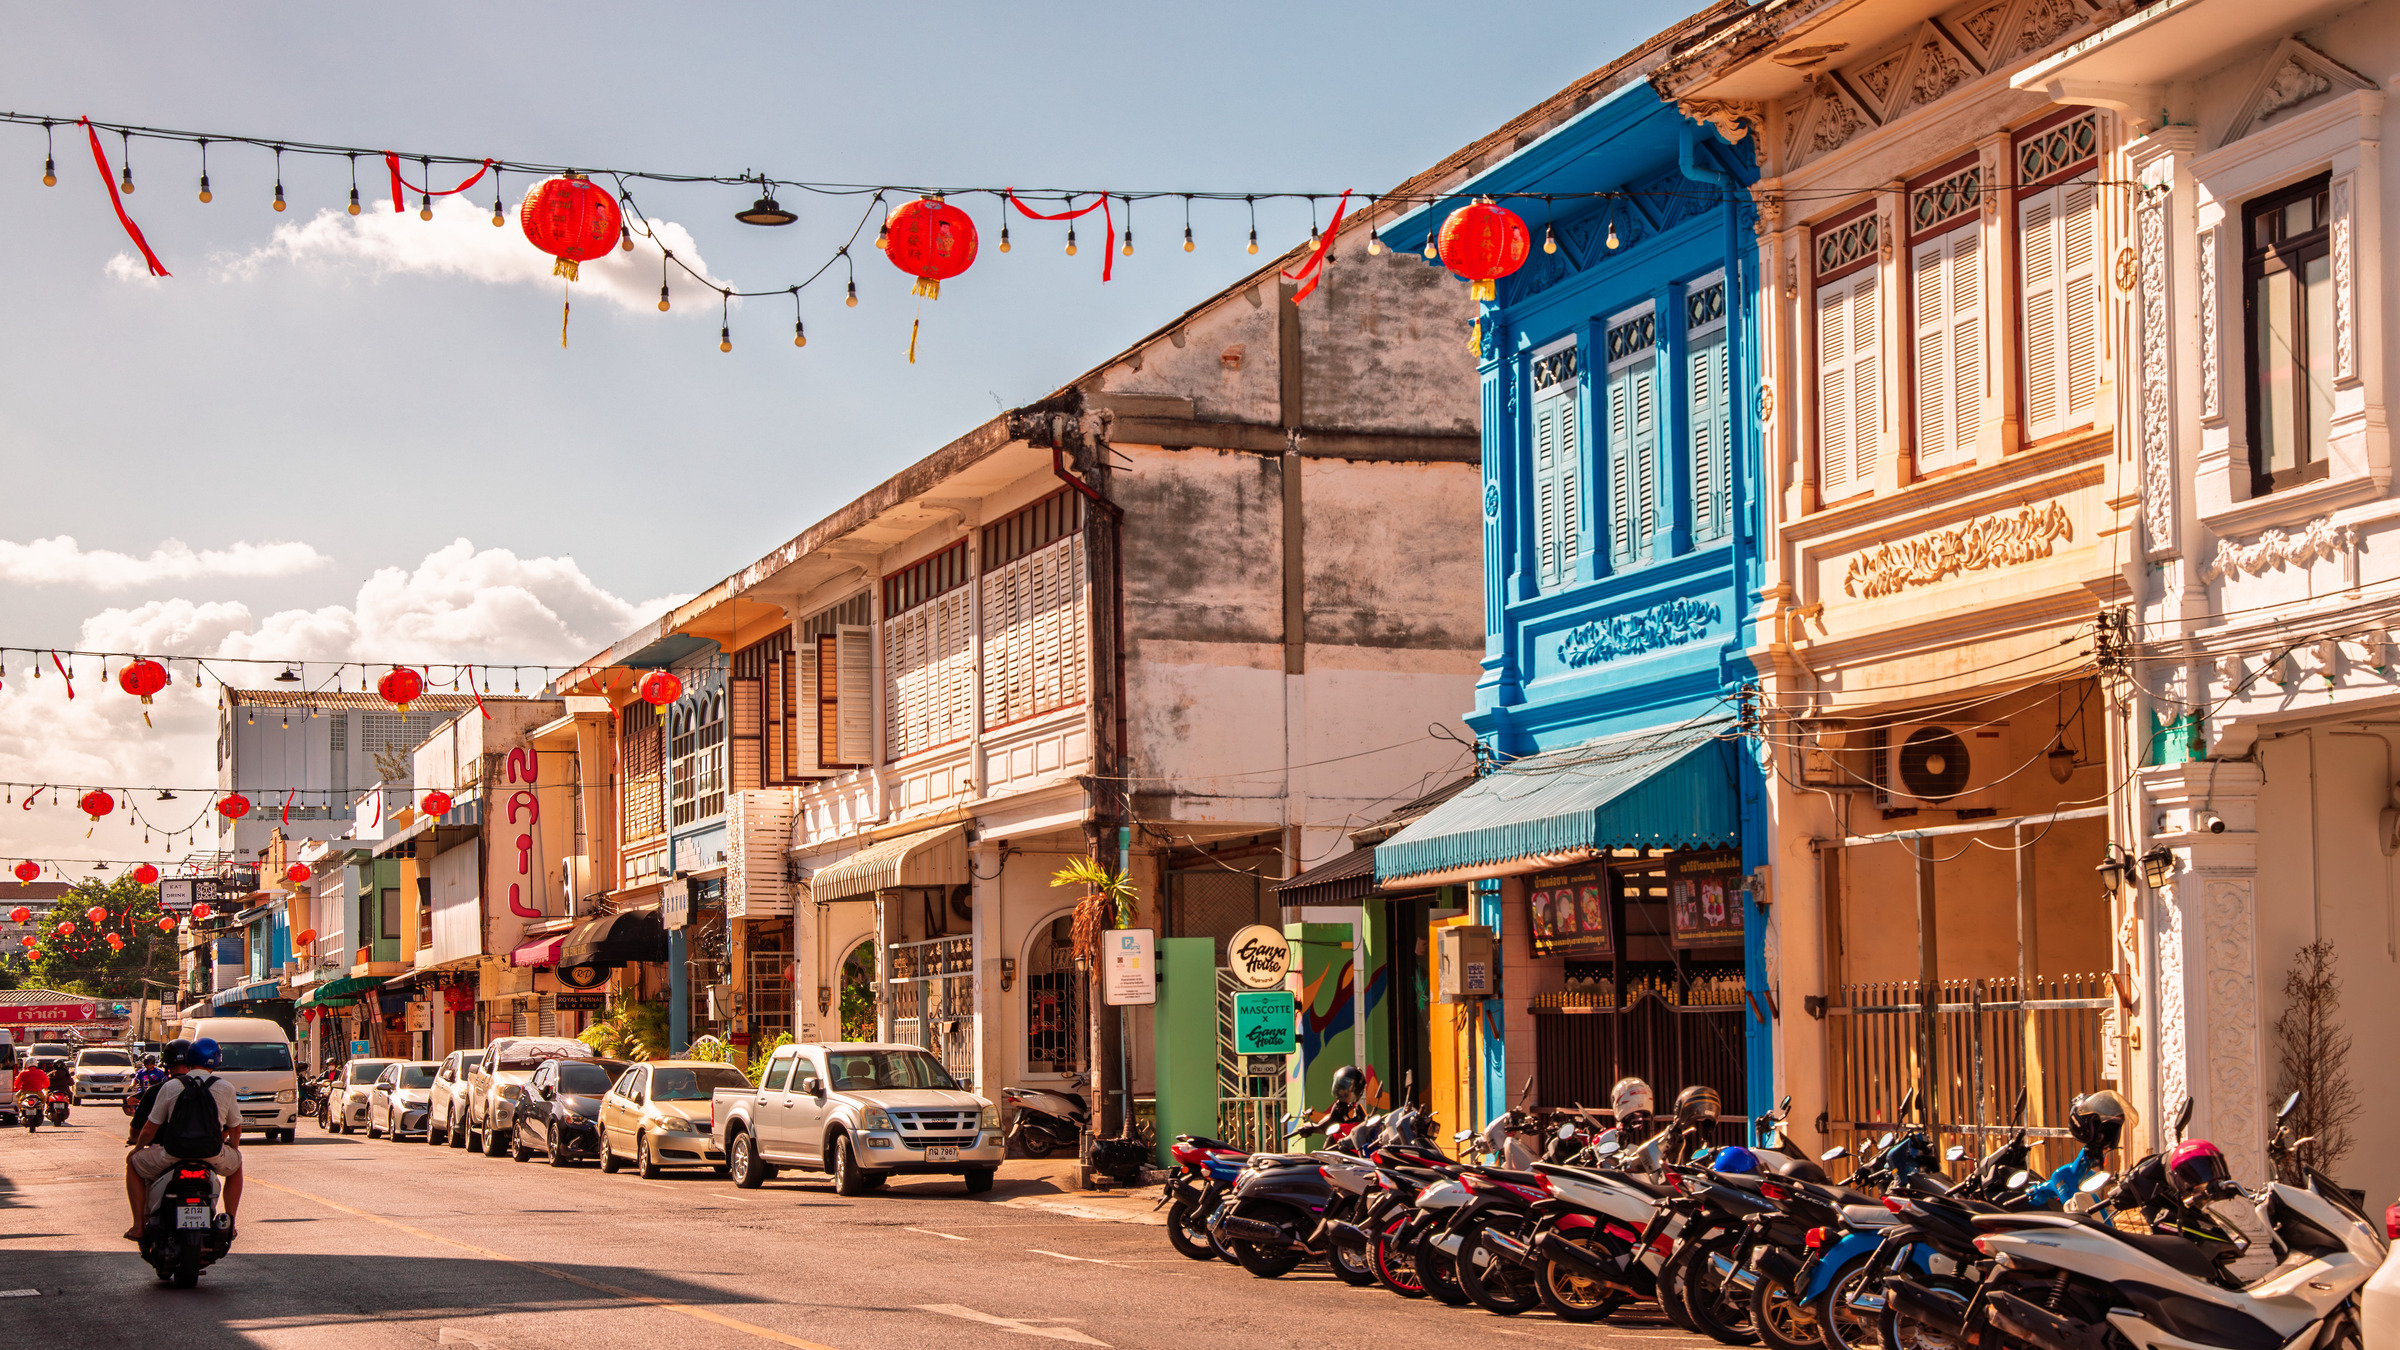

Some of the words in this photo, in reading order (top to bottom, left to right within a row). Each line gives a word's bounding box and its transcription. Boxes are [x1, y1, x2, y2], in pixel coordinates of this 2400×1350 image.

[1236, 938, 1287, 962] Ganya
[1246, 956, 1281, 973] House
[17, 1007, 67, 1020] เจ้าเก่า
[1240, 1005, 1291, 1015] MASCOTTE
[1245, 1025, 1287, 1040] Ganya
[1255, 1035, 1285, 1048] House
[940, 1147, 957, 1156] 7967
[182, 1221, 206, 1229] 4114
